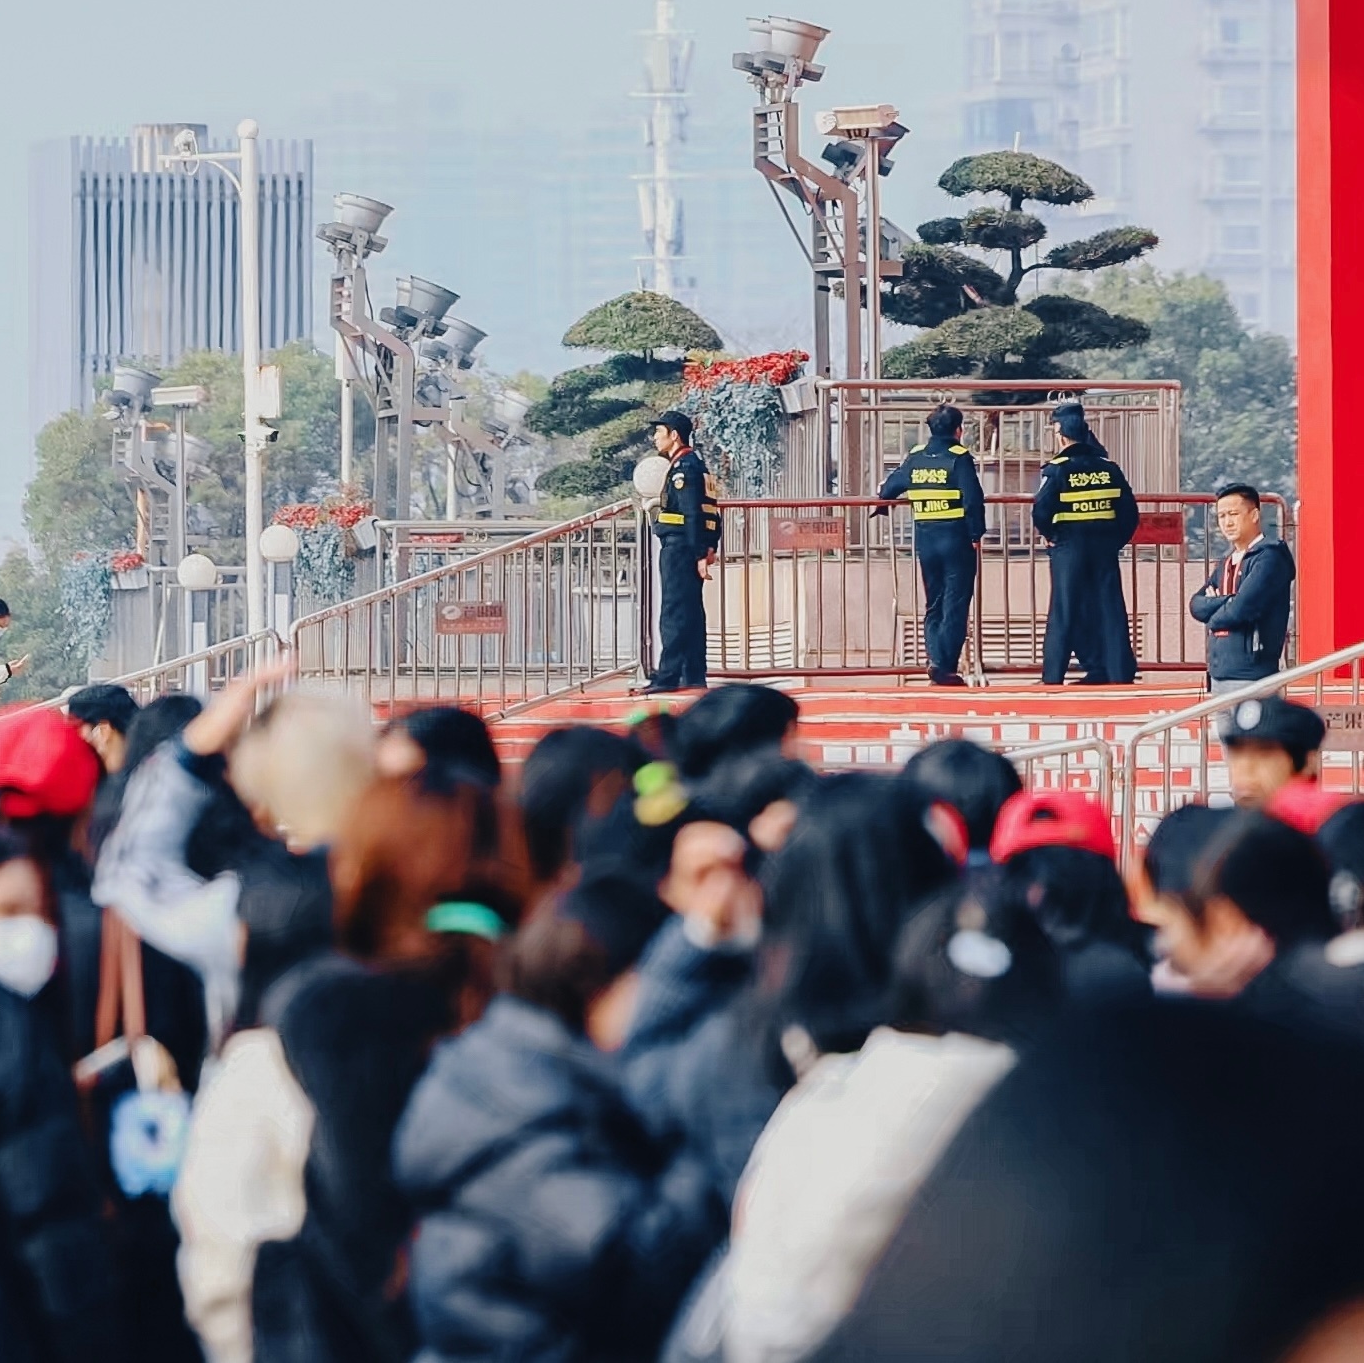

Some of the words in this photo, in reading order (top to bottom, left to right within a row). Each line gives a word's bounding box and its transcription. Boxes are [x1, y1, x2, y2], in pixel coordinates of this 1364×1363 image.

[1068, 471, 1111, 487] 长沙公安
[924, 499, 950, 512] JING
[1072, 500, 1112, 512] POLICE
